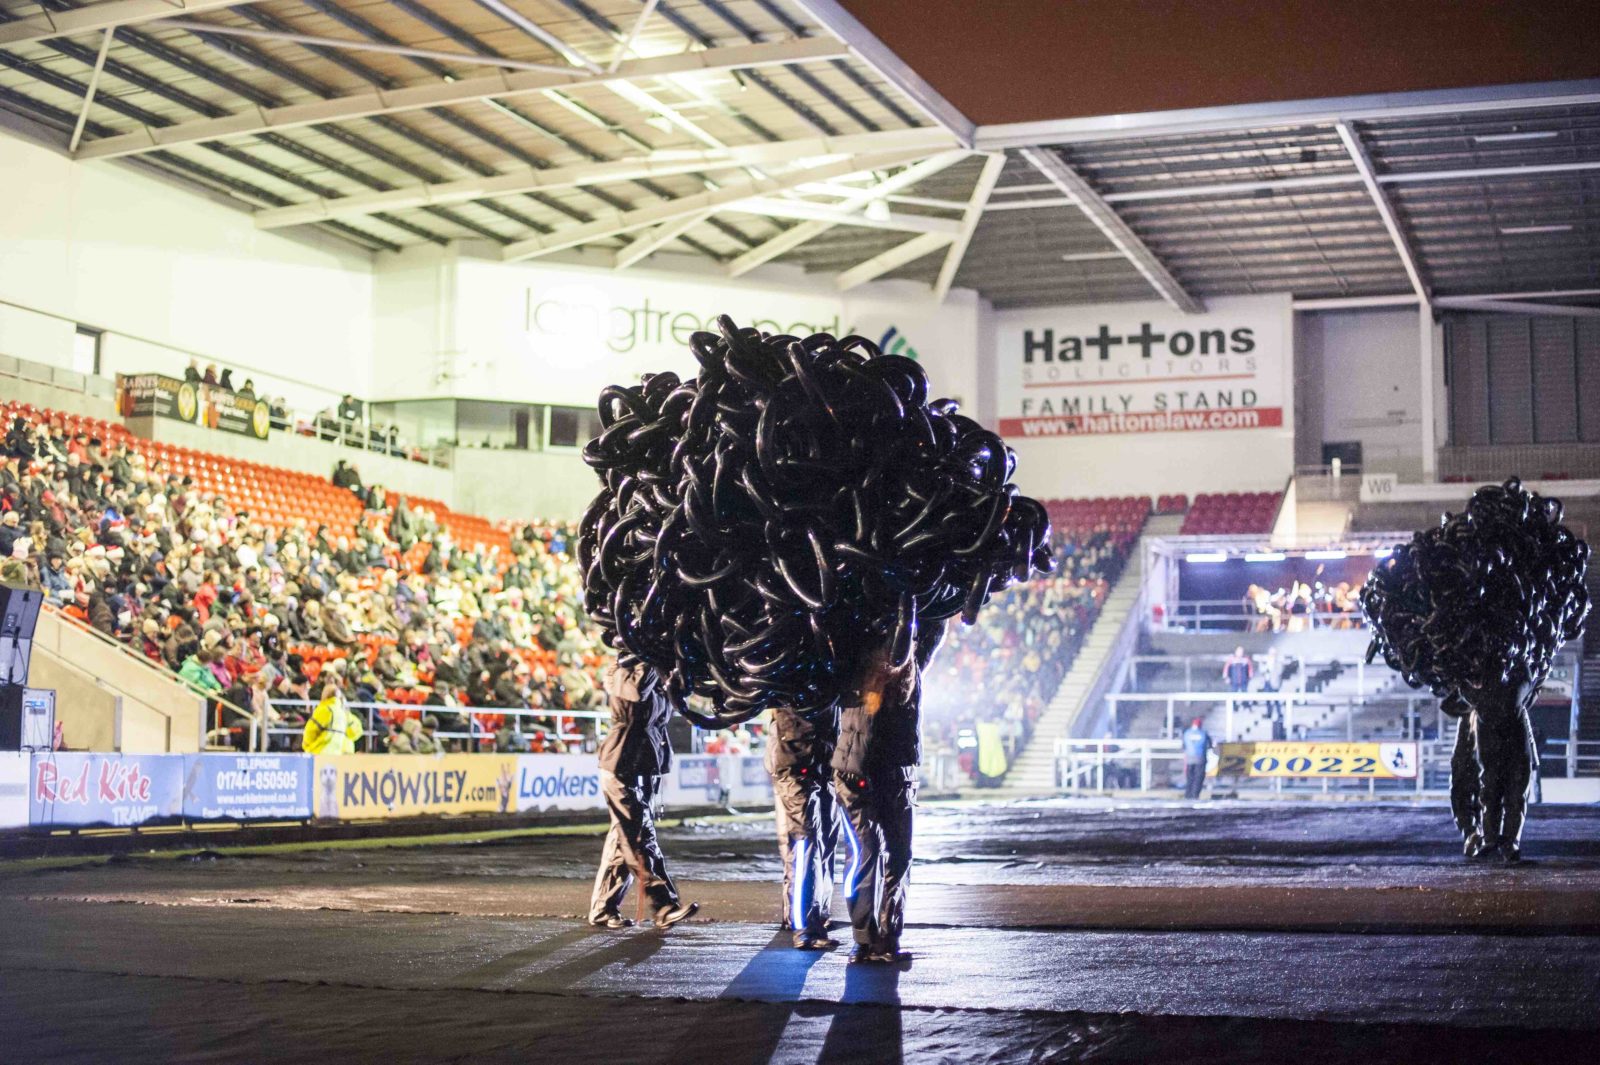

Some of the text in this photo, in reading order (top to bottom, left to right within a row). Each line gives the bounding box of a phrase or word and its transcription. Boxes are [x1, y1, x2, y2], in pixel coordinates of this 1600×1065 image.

[1022, 357, 1257, 381] SOLICITORS
[1022, 389, 1258, 417] FAMILY STAND
[1022, 409, 1259, 436] www.hattonslaw.com
[1368, 478, 1392, 494] W6
[1222, 756, 1376, 773] 20022
[37, 761, 90, 804] Red
[99, 760, 151, 802] Kite
[217, 771, 298, 790] 01744-850505
[519, 767, 599, 799] Lookers
